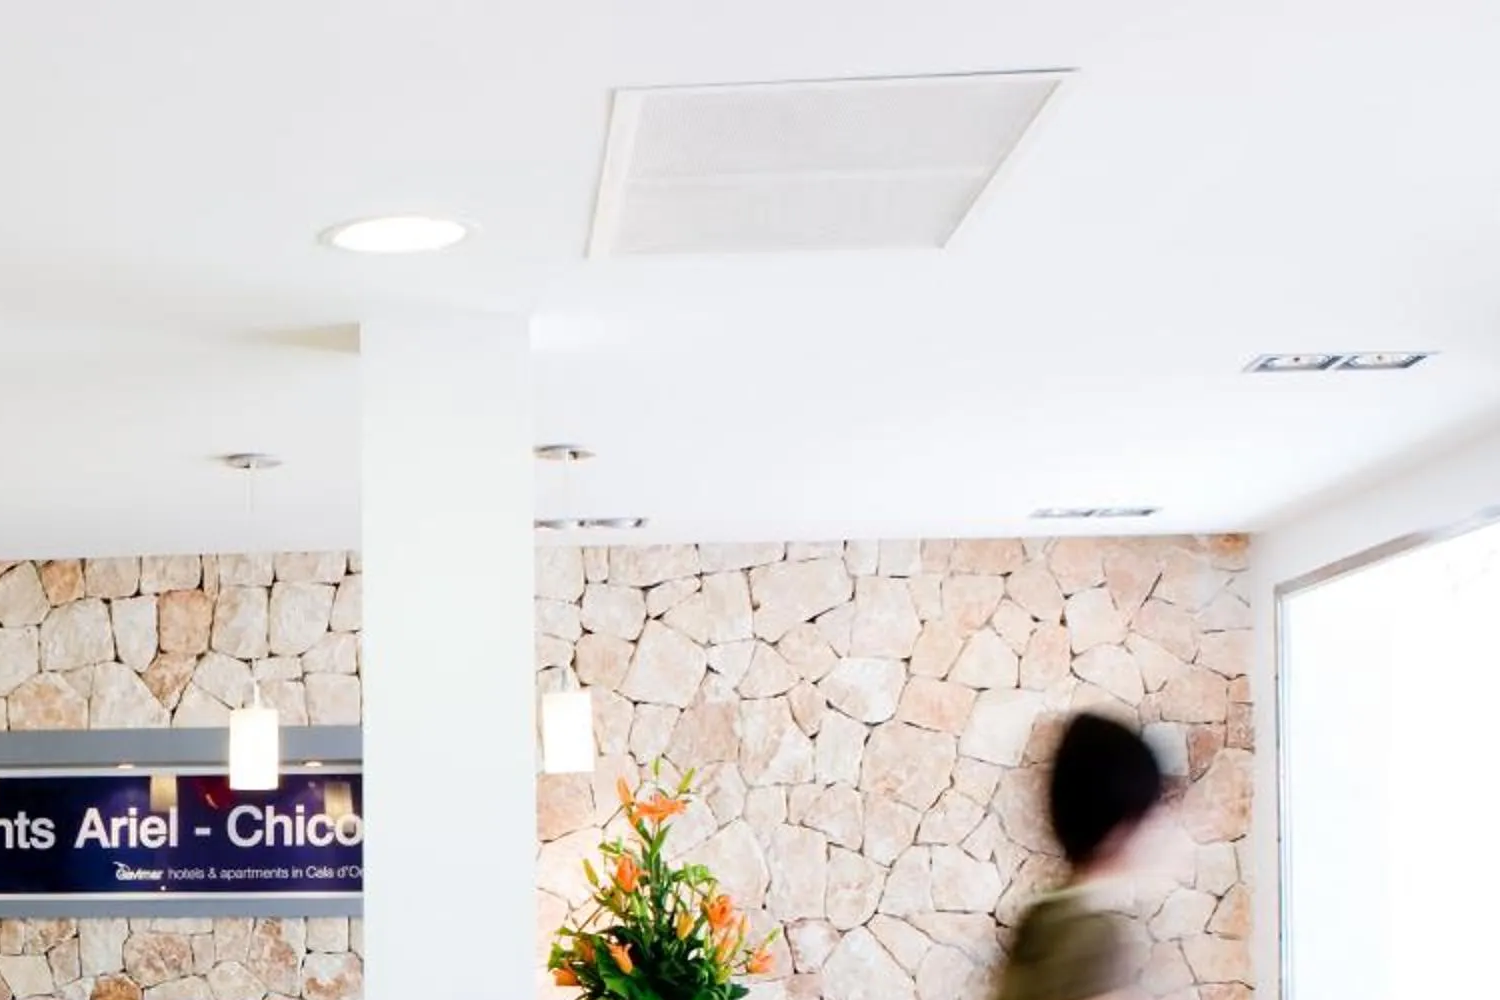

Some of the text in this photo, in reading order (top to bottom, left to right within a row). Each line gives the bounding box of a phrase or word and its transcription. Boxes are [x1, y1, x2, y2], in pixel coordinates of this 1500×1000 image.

[74, 806, 179, 850] Ariel
[226, 803, 363, 848] Chico
[167, 867, 204, 880] hotels
[207, 867, 217, 879] &
[219, 867, 289, 882] apartments
[291, 866, 303, 879] in
[336, 865, 363, 879] d'O
